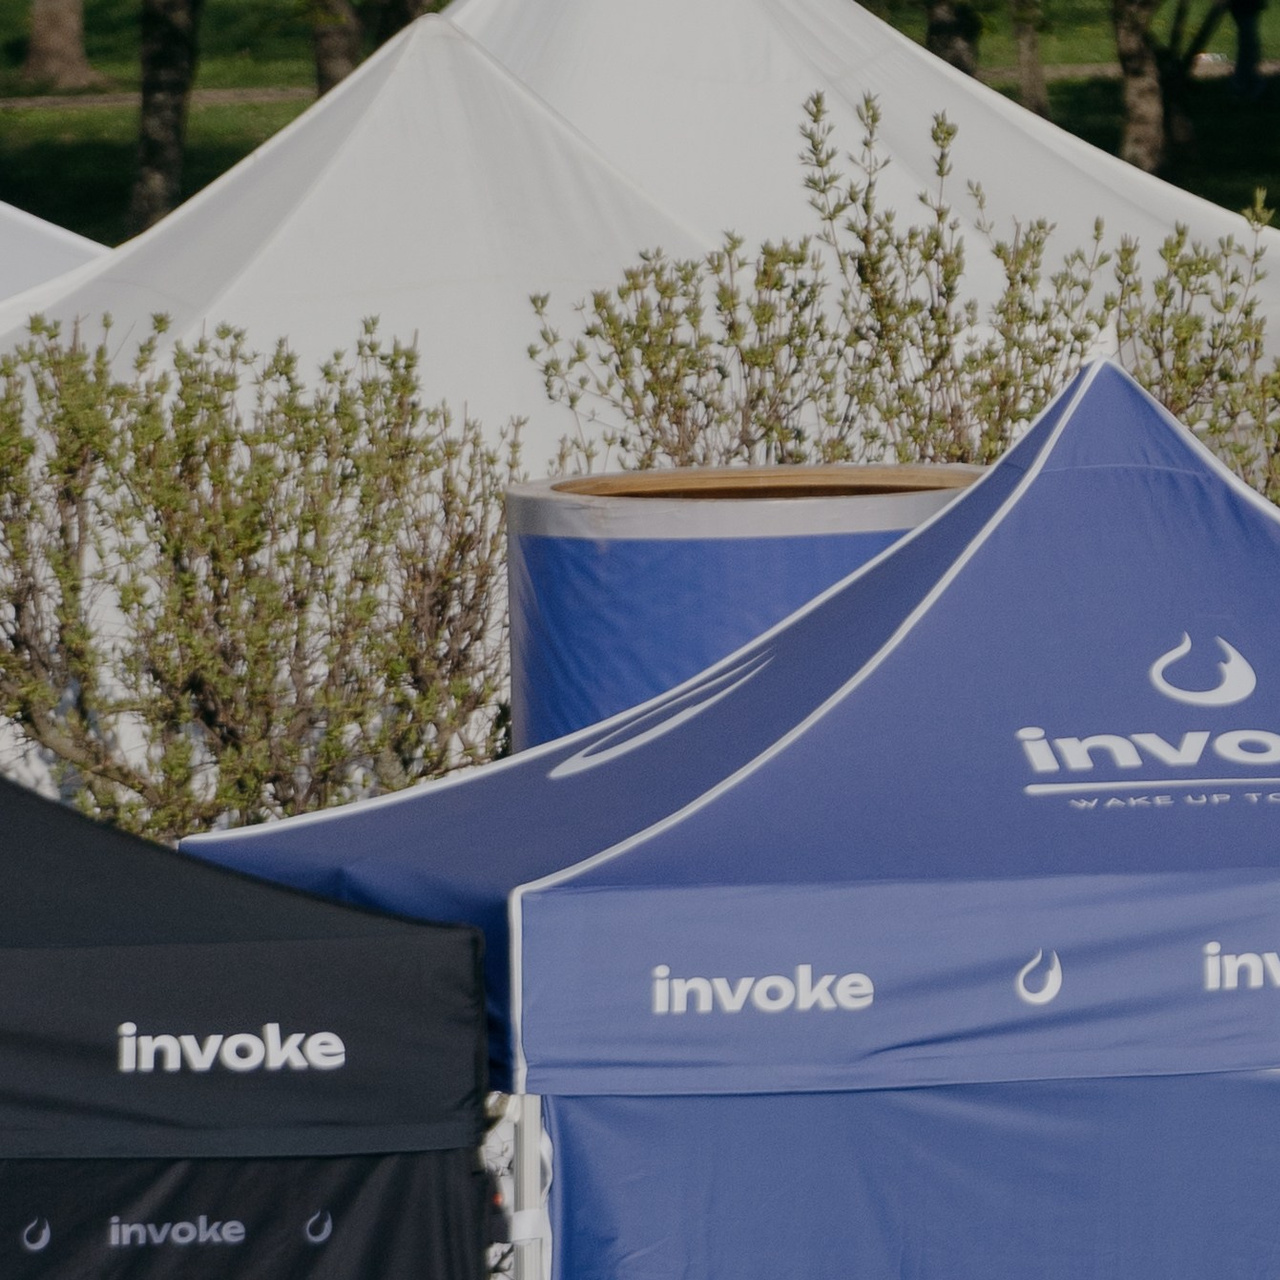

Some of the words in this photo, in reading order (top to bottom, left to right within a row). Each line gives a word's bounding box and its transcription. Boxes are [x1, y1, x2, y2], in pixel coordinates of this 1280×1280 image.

[1069, 796, 1174, 809] WAKE
[1185, 793, 1231, 805] UP
[653, 964, 874, 1014] invoke
[118, 1021, 346, 1072] invoke
[108, 1214, 246, 1247] invoke
